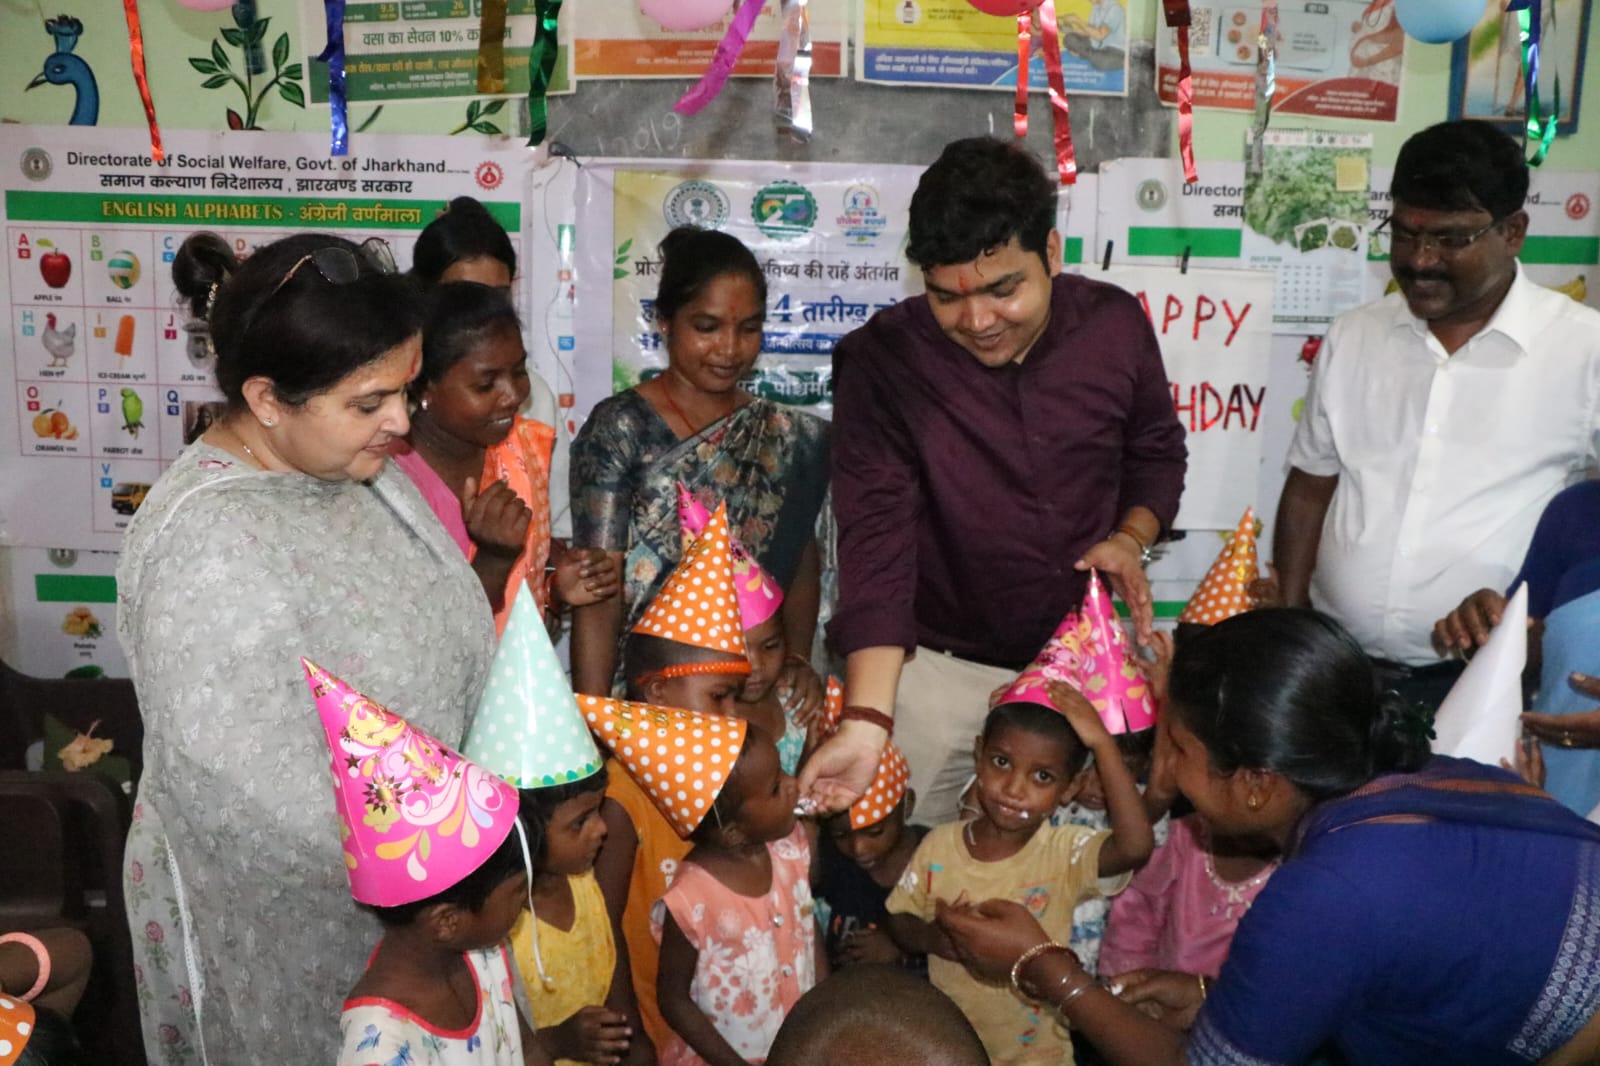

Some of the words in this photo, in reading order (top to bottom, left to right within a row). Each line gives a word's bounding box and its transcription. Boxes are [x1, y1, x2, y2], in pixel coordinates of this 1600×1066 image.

[362, 31, 385, 46] वसा
[387, 30, 404, 45] का
[407, 27, 437, 43] सेवन
[439, 30, 464, 43] 10%
[67, 151, 152, 168] Directorate
[157, 154, 173, 168] of
[177, 154, 224, 169] Social
[229, 155, 291, 172] Welfare,
[295, 157, 338, 171] Govt.
[342, 157, 357, 172] of
[361, 159, 446, 174] Jharkhand
[100, 174, 146, 188] समाज
[150, 175, 206, 190] कल्याण
[211, 172, 283, 191] निदेशालय
[296, 178, 357, 193] झारखण्ड
[361, 180, 413, 194] सरकार
[1182, 182, 1244, 197] Director
[102, 200, 177, 218] ENGLISH
[183, 203, 283, 220] ALPHABETS
[300, 201, 347, 222] अंग्रेजी
[351, 205, 422, 223] वर्णमाला
[1213, 204, 1245, 217] समा
[19, 233, 30, 246] A
[91, 234, 100, 248] B
[163, 236, 173, 250] C
[236, 238, 246, 252] D
[804, 258, 823, 279] की
[22, 310, 34, 323] H
[168, 313, 174, 327] J
[27, 385, 39, 399] O
[98, 388, 107, 401] P
[167, 389, 179, 403] Q
[1171, 380, 1267, 433] HDAY
[101, 463, 111, 475] V
